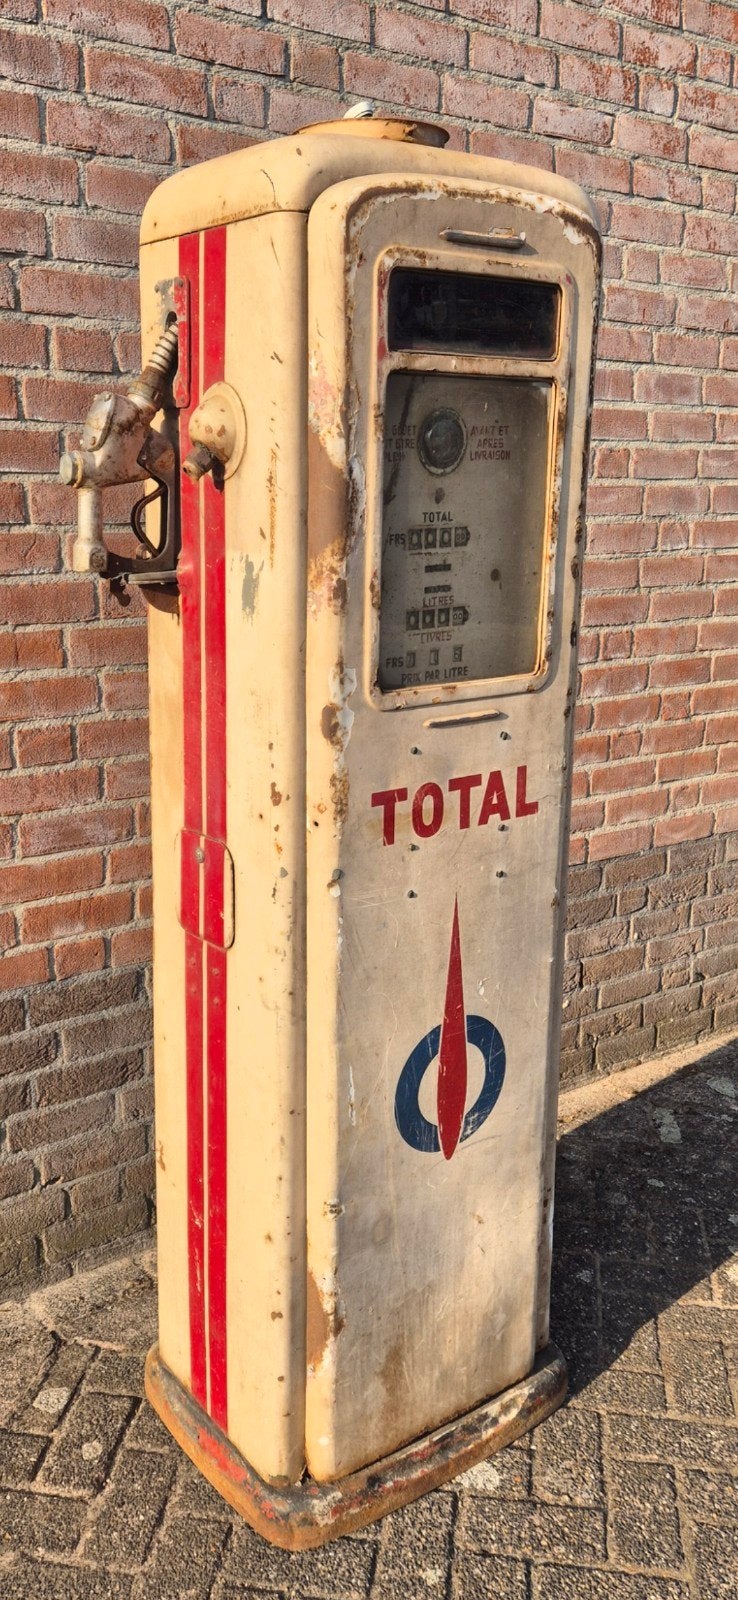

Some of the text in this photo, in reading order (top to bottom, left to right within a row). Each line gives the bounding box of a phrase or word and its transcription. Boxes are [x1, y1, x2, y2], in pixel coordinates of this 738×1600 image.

[498, 425, 510, 436] ET
[469, 450, 511, 461] LIVRAISON
[422, 511, 454, 523] TOTAL
[388, 533, 406, 546] FRS
[422, 595, 454, 608] LITRES
[385, 656, 404, 669] FRS
[424, 669, 440, 681] PAR
[444, 666, 469, 679] LITRE
[371, 765, 539, 847] TOTAL
